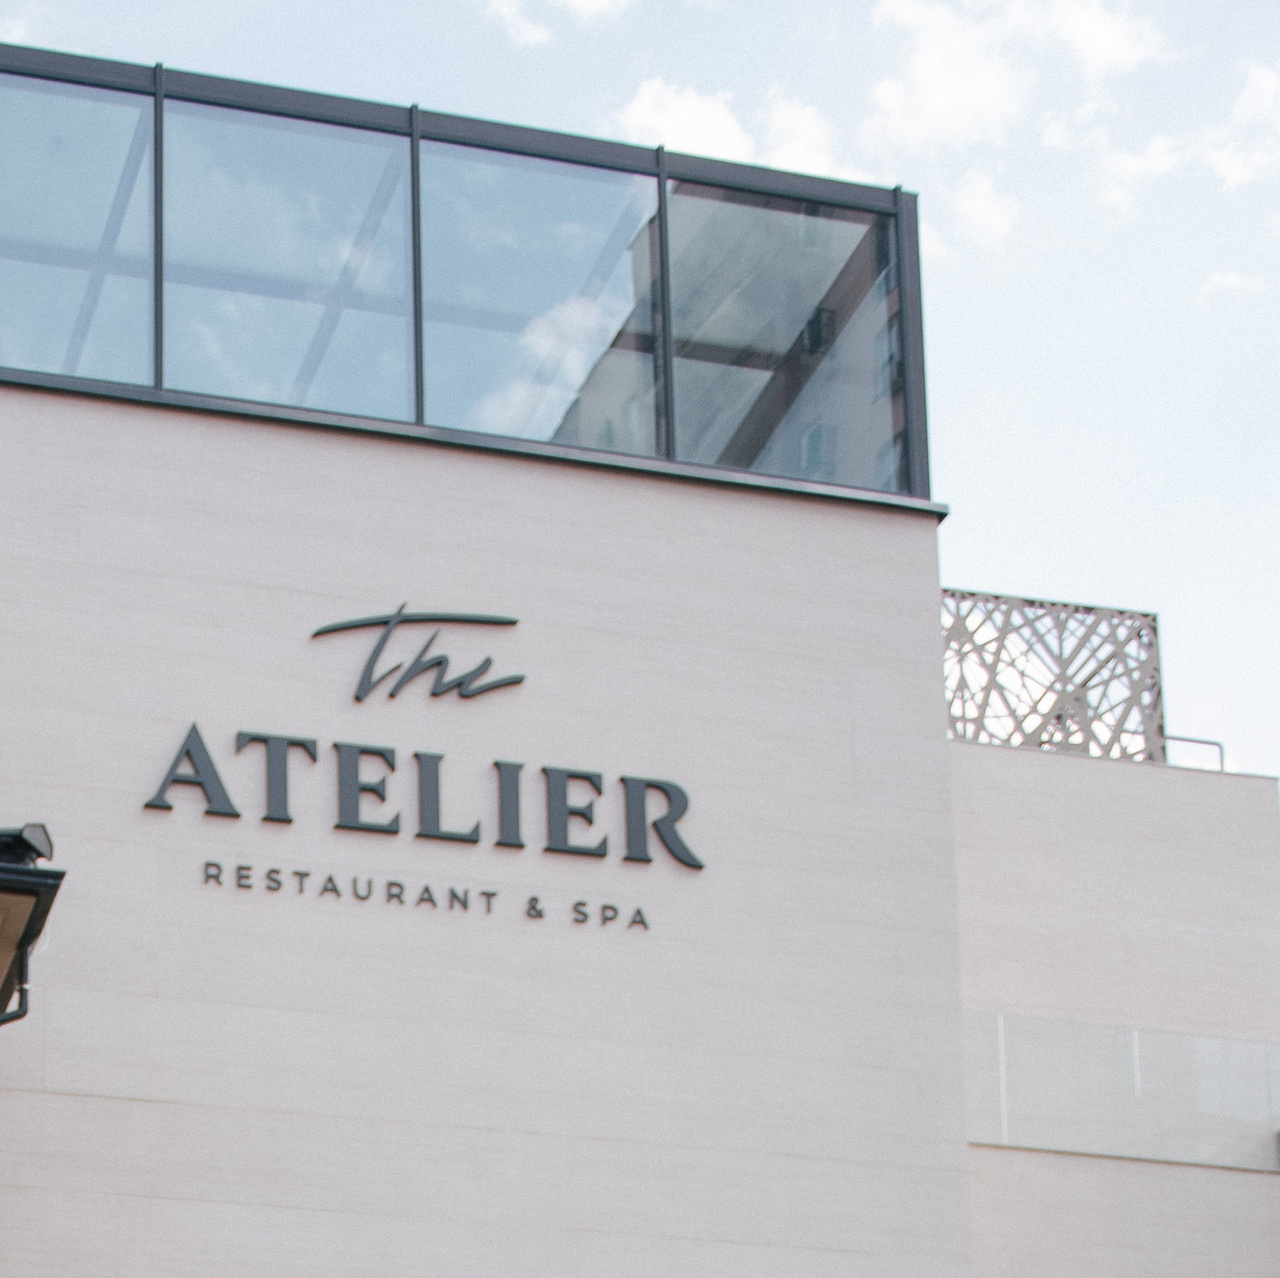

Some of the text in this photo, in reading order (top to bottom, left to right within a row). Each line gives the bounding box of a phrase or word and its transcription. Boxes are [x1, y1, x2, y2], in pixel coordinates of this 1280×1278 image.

[312, 602, 525, 702] The
[144, 722, 704, 870] ATELIER
[203, 862, 649, 930] RESTAURANT & SPA
